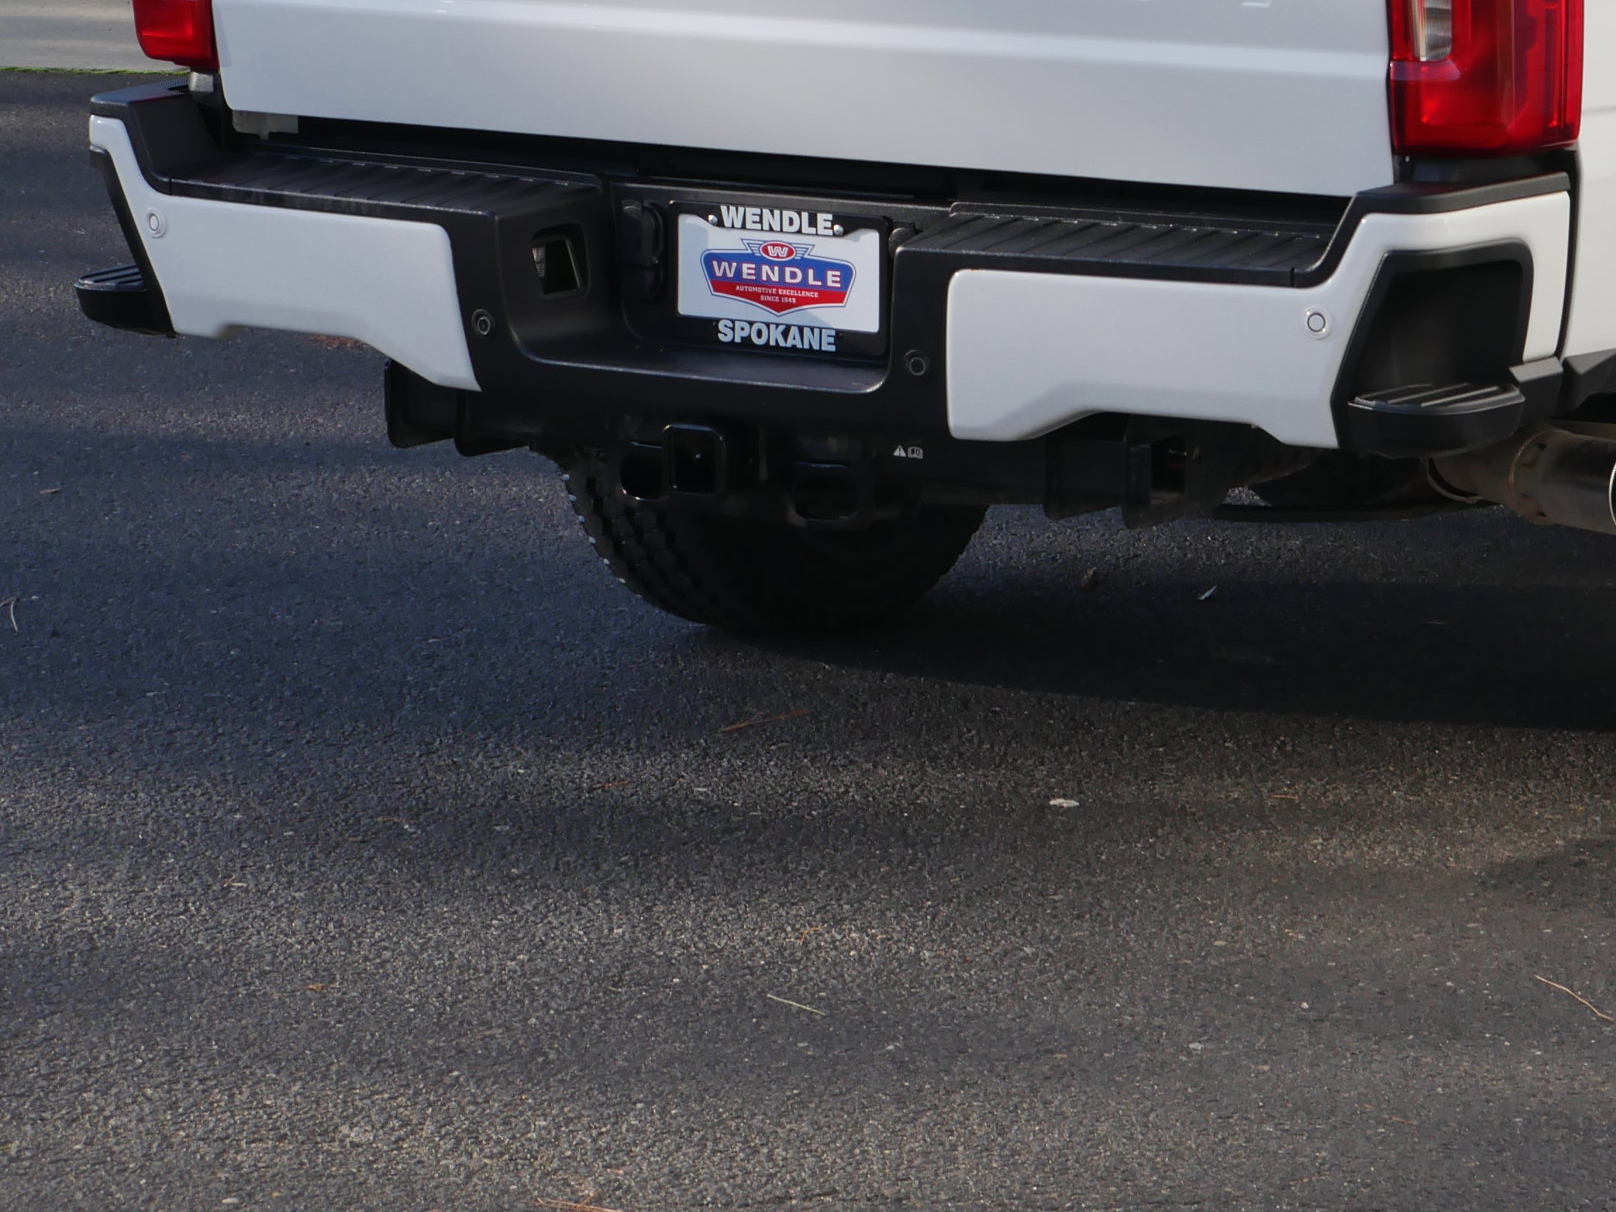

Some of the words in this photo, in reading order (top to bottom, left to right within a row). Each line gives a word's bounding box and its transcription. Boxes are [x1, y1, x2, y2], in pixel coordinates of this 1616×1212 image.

[720, 205, 834, 236] WENDLE
[766, 245, 789, 257] W
[711, 260, 842, 288] WENDLE
[735, 284, 777, 295] AUTOMOTIVE
[778, 288, 819, 299] EXCELLENCE
[760, 295, 780, 303] SINCE
[717, 319, 837, 352] SPOKANE
